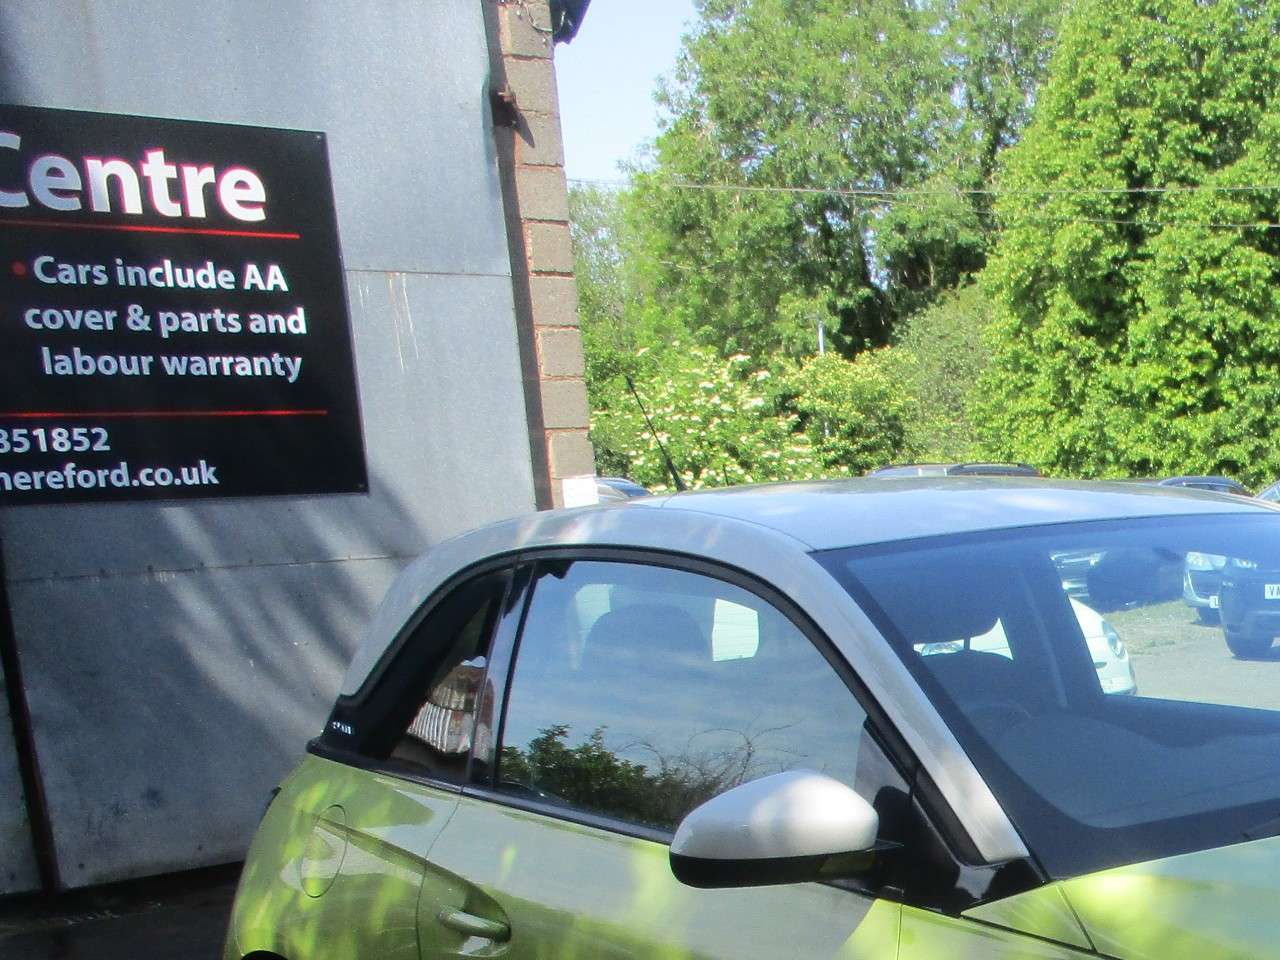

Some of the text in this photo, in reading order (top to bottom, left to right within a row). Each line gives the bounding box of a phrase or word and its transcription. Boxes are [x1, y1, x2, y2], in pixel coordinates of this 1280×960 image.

[33, 255, 290, 292] Cars include AA
[24, 304, 308, 338] cover & parts and
[41, 346, 302, 383] labour warranty
